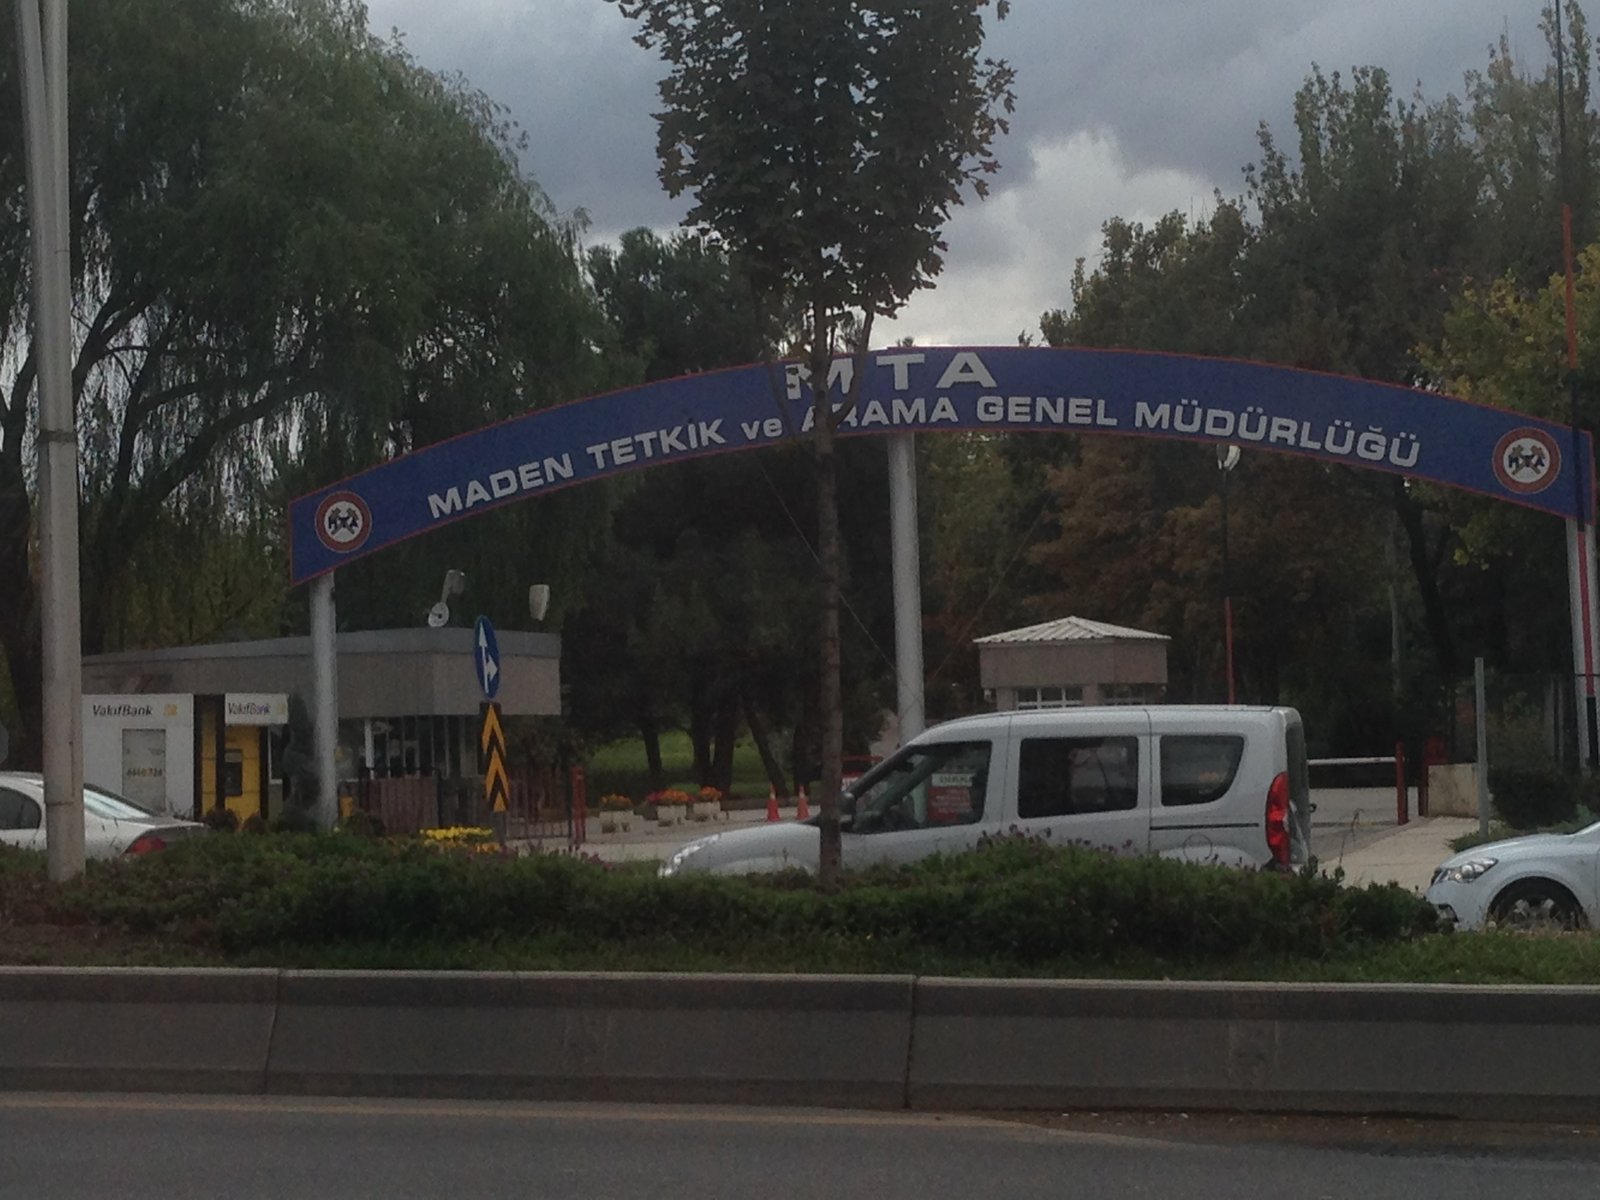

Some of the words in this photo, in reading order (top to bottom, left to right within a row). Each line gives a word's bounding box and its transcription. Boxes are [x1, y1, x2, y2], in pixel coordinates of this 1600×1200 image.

[785, 351, 998, 400] MTA
[428, 452, 575, 520] MADEN
[741, 417, 784, 441] ve
[976, 395, 1119, 427] GENEL
[1134, 398, 1421, 468] MÜDÜRLÜĞÜ
